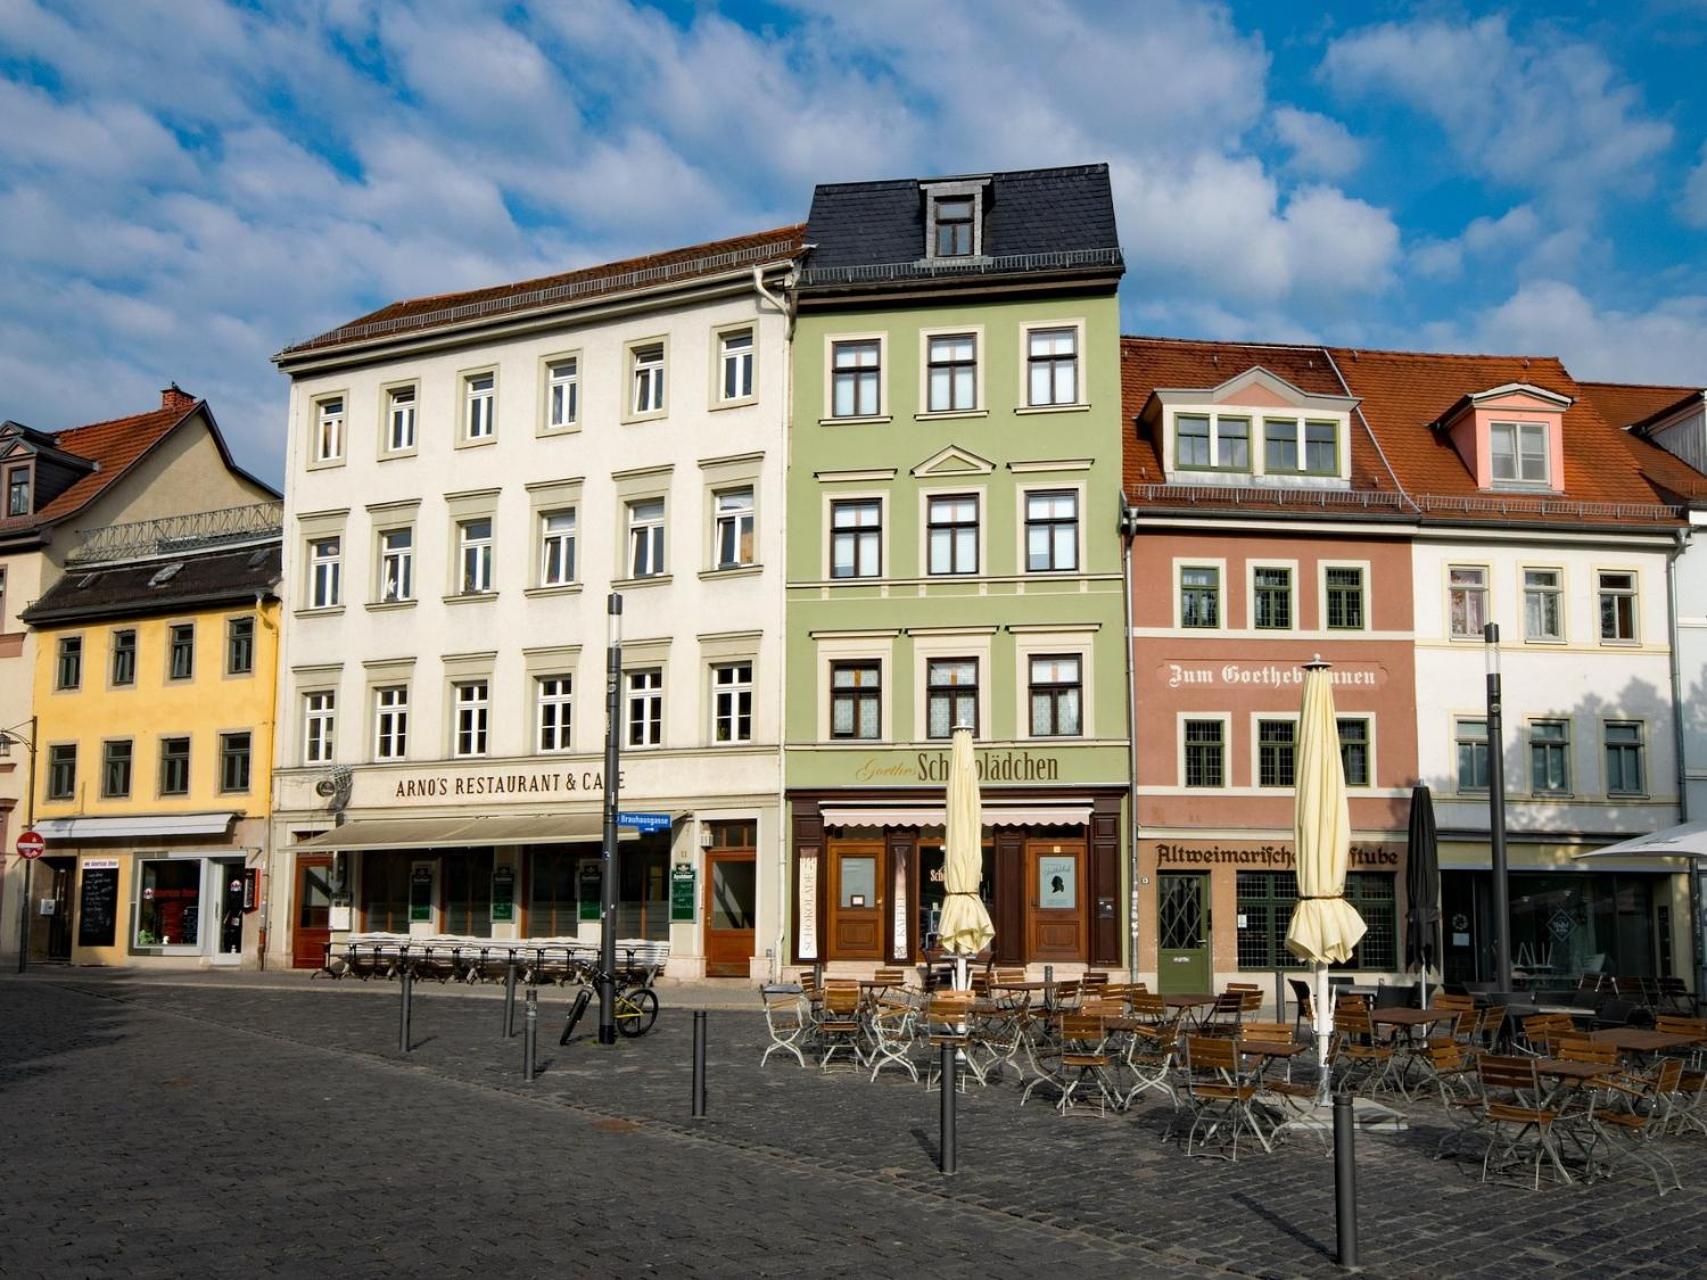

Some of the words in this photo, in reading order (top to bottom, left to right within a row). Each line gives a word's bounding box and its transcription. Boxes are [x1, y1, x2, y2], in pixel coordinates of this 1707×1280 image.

[1168, 664, 1213, 687] Zum
[1222, 664, 1376, 688] Goethebnnen
[917, 752, 1058, 781] Scholädchen
[396, 777, 448, 797] ARNO'S
[455, 774, 561, 795] RESTAURANT
[566, 773, 577, 791] &
[582, 770, 626, 791] CAE
[620, 814, 669, 826] Brauhausgasse
